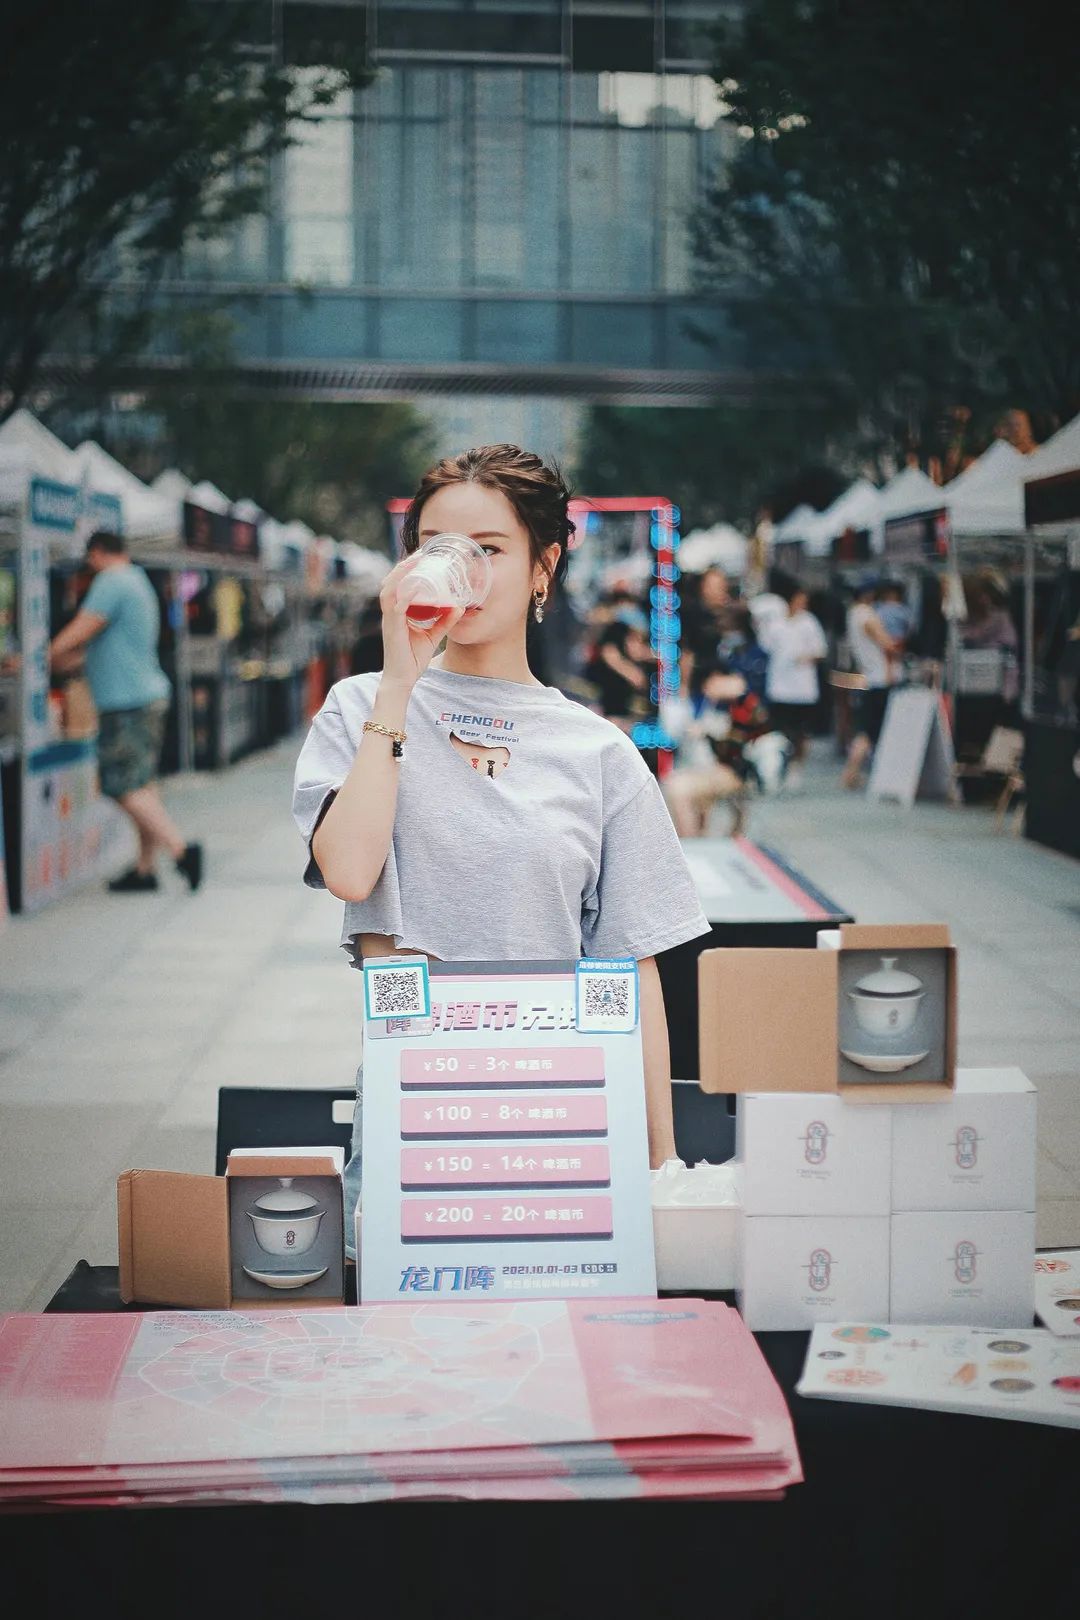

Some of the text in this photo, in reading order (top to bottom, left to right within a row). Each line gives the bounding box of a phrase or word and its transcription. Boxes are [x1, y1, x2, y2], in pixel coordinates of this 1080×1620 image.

[460, 729, 520, 743] Beer Festival
[423, 1057, 459, 1072] ¥50
[486, 1057, 510, 1071] 3个
[423, 1105, 472, 1121] ¥100
[499, 1105, 524, 1120] 8个
[423, 1156, 473, 1172] ¥150
[501, 1155, 538, 1171] 14个
[424, 1207, 474, 1223] ¥200
[502, 1206, 539, 1222] 20个
[502, 1265, 605, 1275] 2021.10.01-03 CDC
[398, 1265, 496, 1292] 龙门阵
